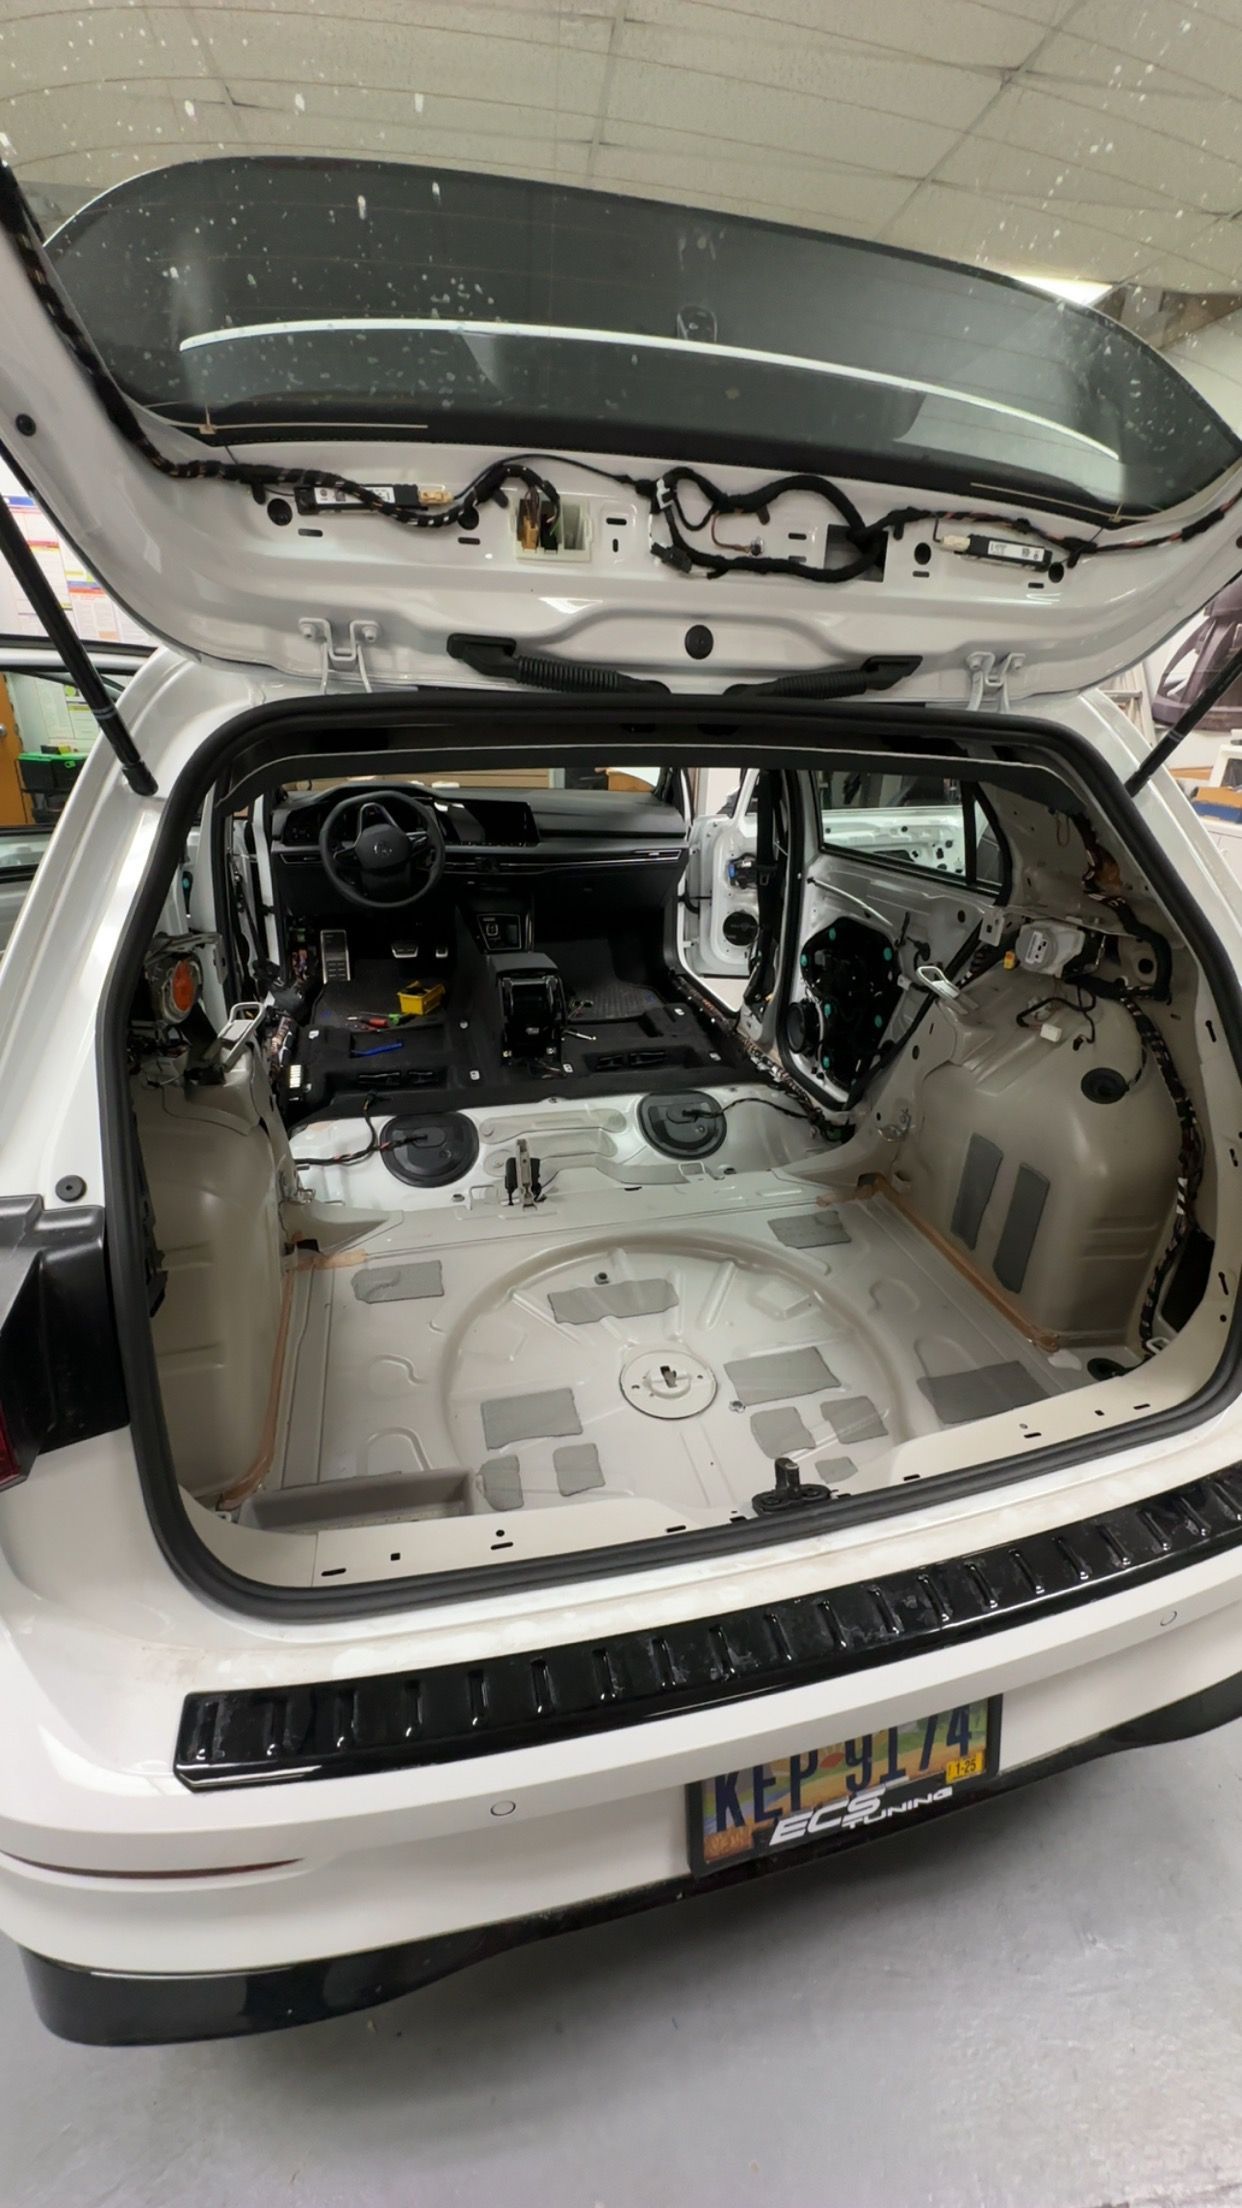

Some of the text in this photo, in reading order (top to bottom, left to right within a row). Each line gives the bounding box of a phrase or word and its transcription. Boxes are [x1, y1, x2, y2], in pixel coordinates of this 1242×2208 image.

[714, 1704, 972, 1832] KEP 9174
[768, 1776, 909, 1847] ECS
[844, 1786, 953, 1829] TUNING
